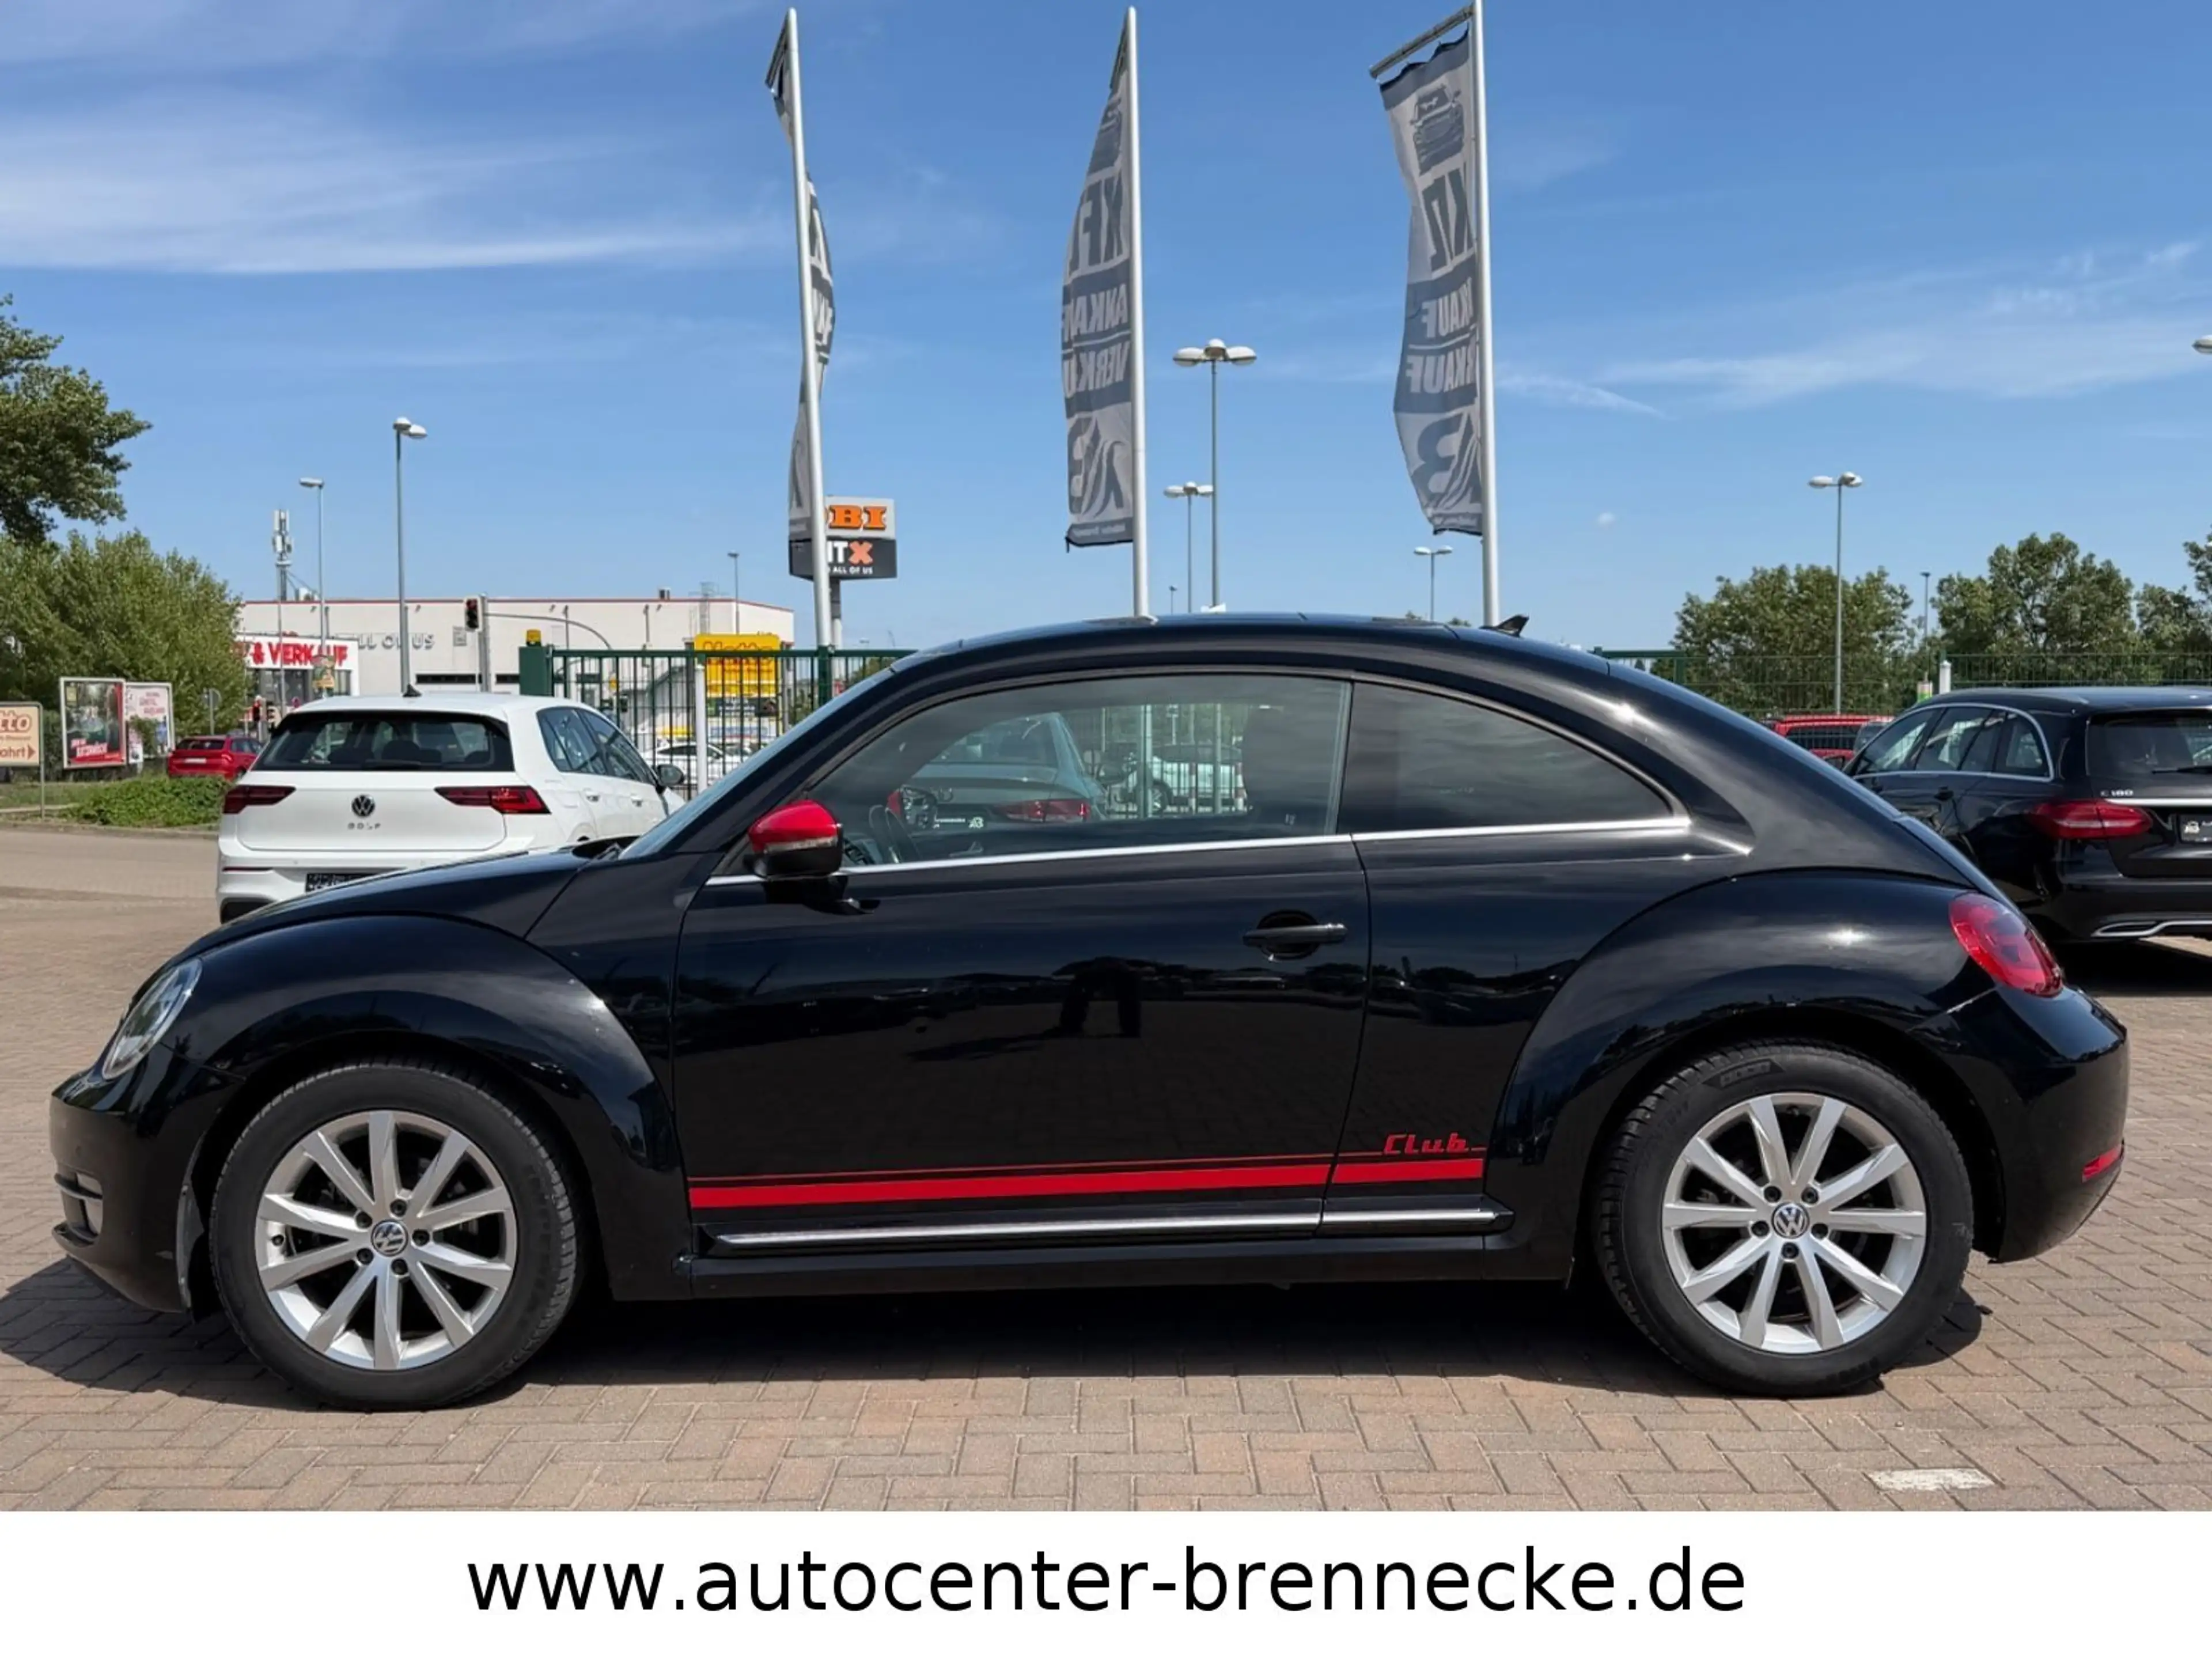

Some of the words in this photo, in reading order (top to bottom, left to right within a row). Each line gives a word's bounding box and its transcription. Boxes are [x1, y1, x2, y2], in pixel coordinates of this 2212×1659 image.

[825, 505, 888, 531] BI
[827, 540, 873, 565] ITX
[1384, 1132, 1469, 1154] Club
